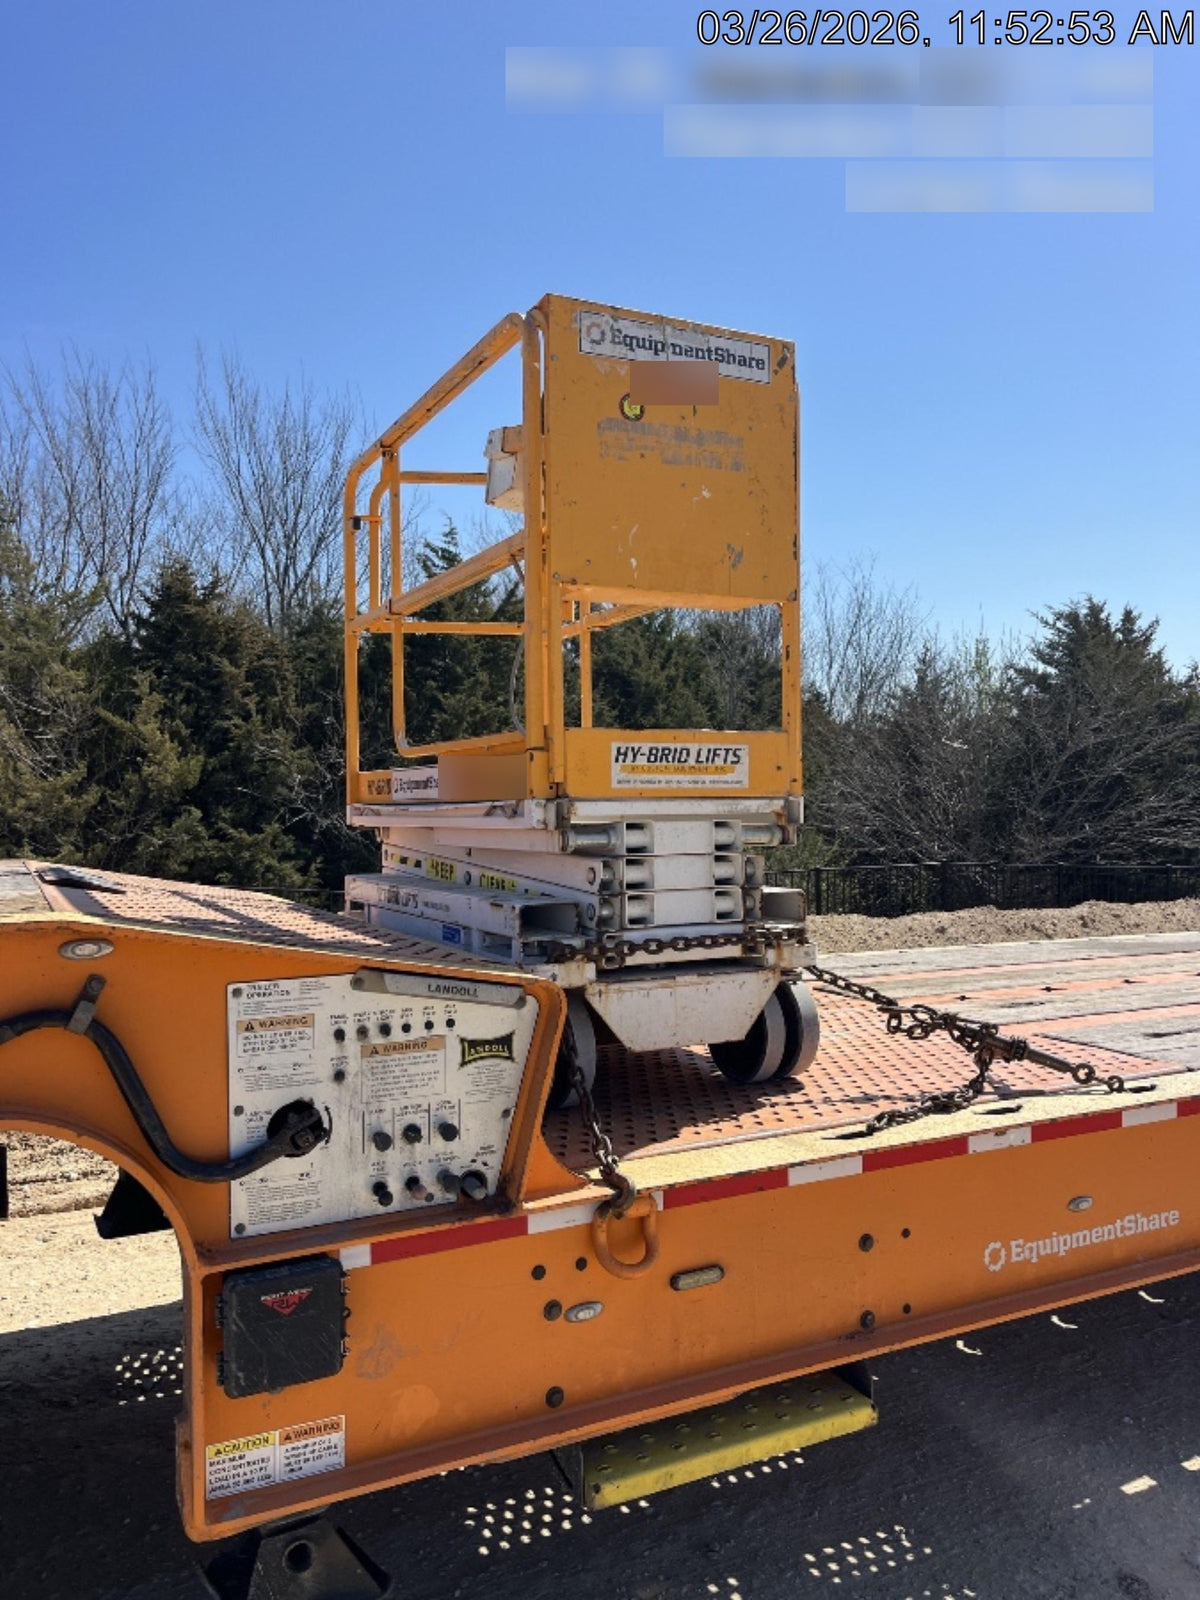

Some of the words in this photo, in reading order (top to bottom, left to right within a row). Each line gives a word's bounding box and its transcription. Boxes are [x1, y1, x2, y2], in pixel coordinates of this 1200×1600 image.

[615, 746, 690, 764] HY-BRID
[696, 747, 742, 765] LIFTS
[428, 984, 479, 998] LANDOLL
[259, 1016, 308, 1029] WARNING
[383, 1041, 428, 1054] WARNING
[465, 1040, 510, 1062] LANDOLL
[1010, 1209, 1180, 1263] EquipmentShare
[293, 1421, 340, 1438] WARNING
[223, 1436, 270, 1454] CAUTION
